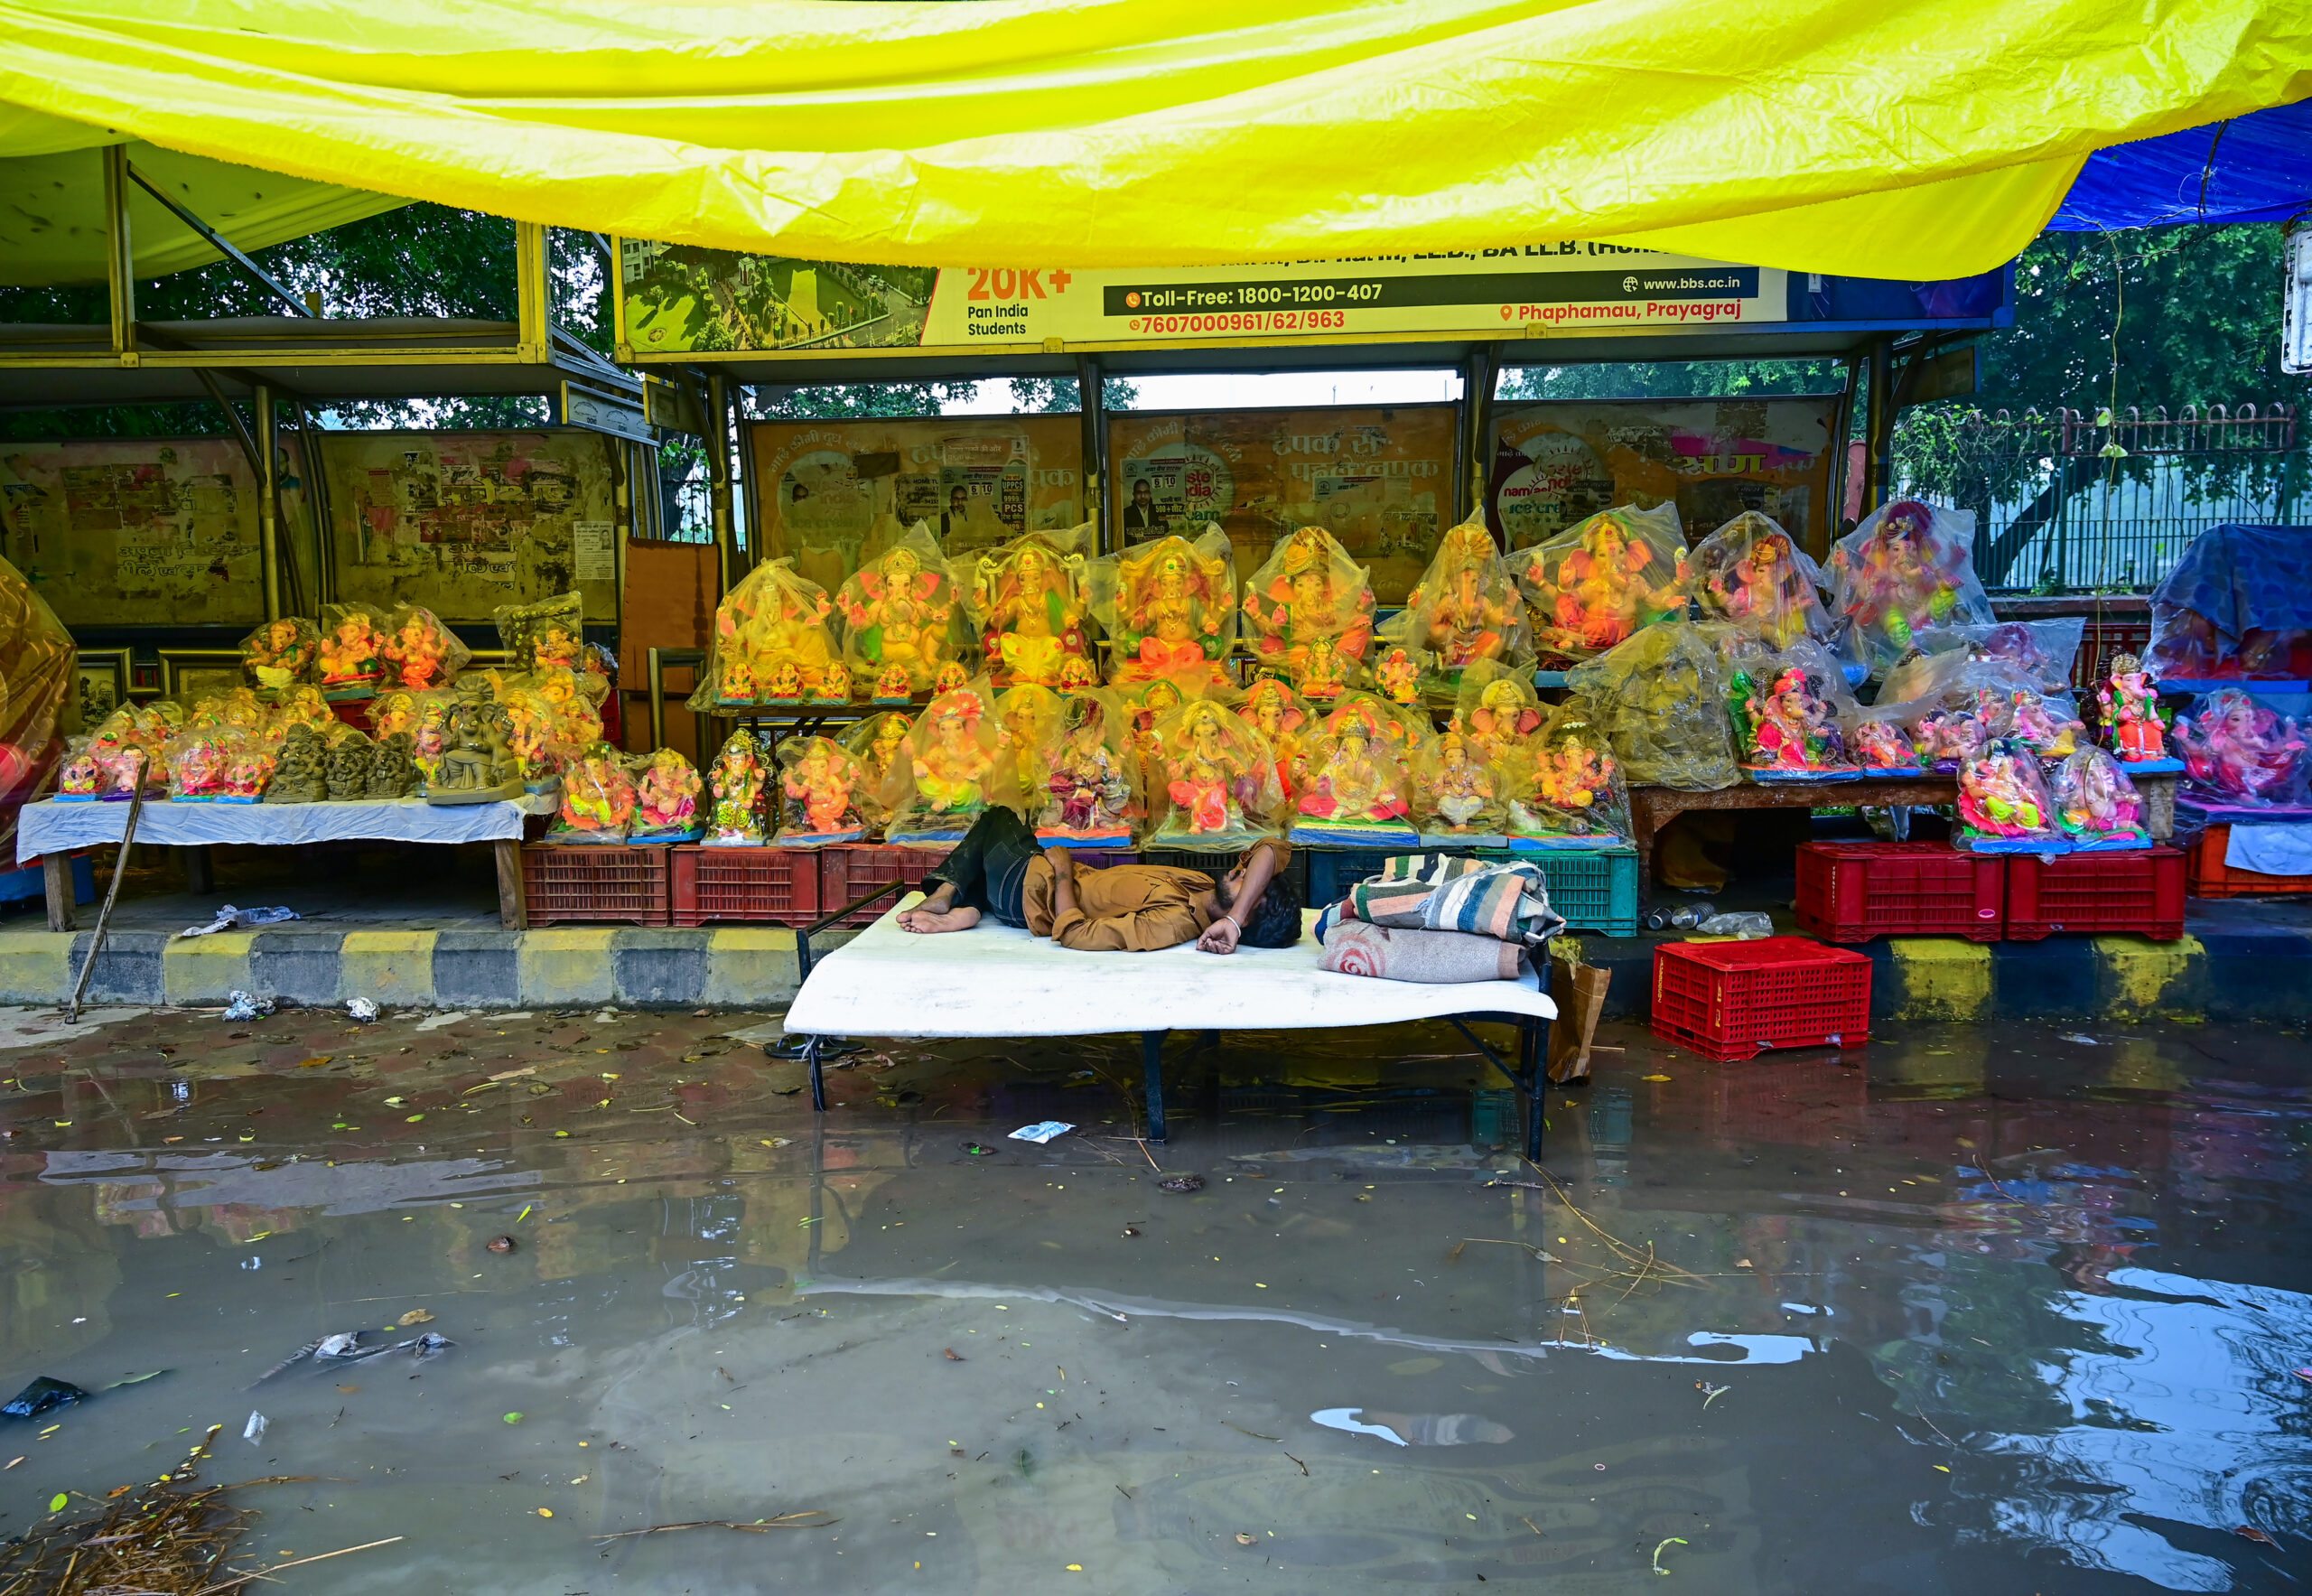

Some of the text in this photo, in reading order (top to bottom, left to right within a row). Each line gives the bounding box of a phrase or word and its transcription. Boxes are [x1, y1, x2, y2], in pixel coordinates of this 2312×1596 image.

[967, 267, 1071, 301] 20K+
[1644, 275, 1740, 290] www.bbs.ac.in
[1142, 284, 1383, 307] Toll-Free: 1800-1200-407
[967, 303, 1029, 319] Pan India
[1519, 299, 1742, 323] Phaphamau, Prayagraj
[968, 322, 1027, 336] Students
[1142, 311, 1345, 333] 7607000961/62/963
[983, 485, 993, 493] 10
[1002, 481, 1023, 490] UPPCS
[1004, 504, 1023, 513] PCS
